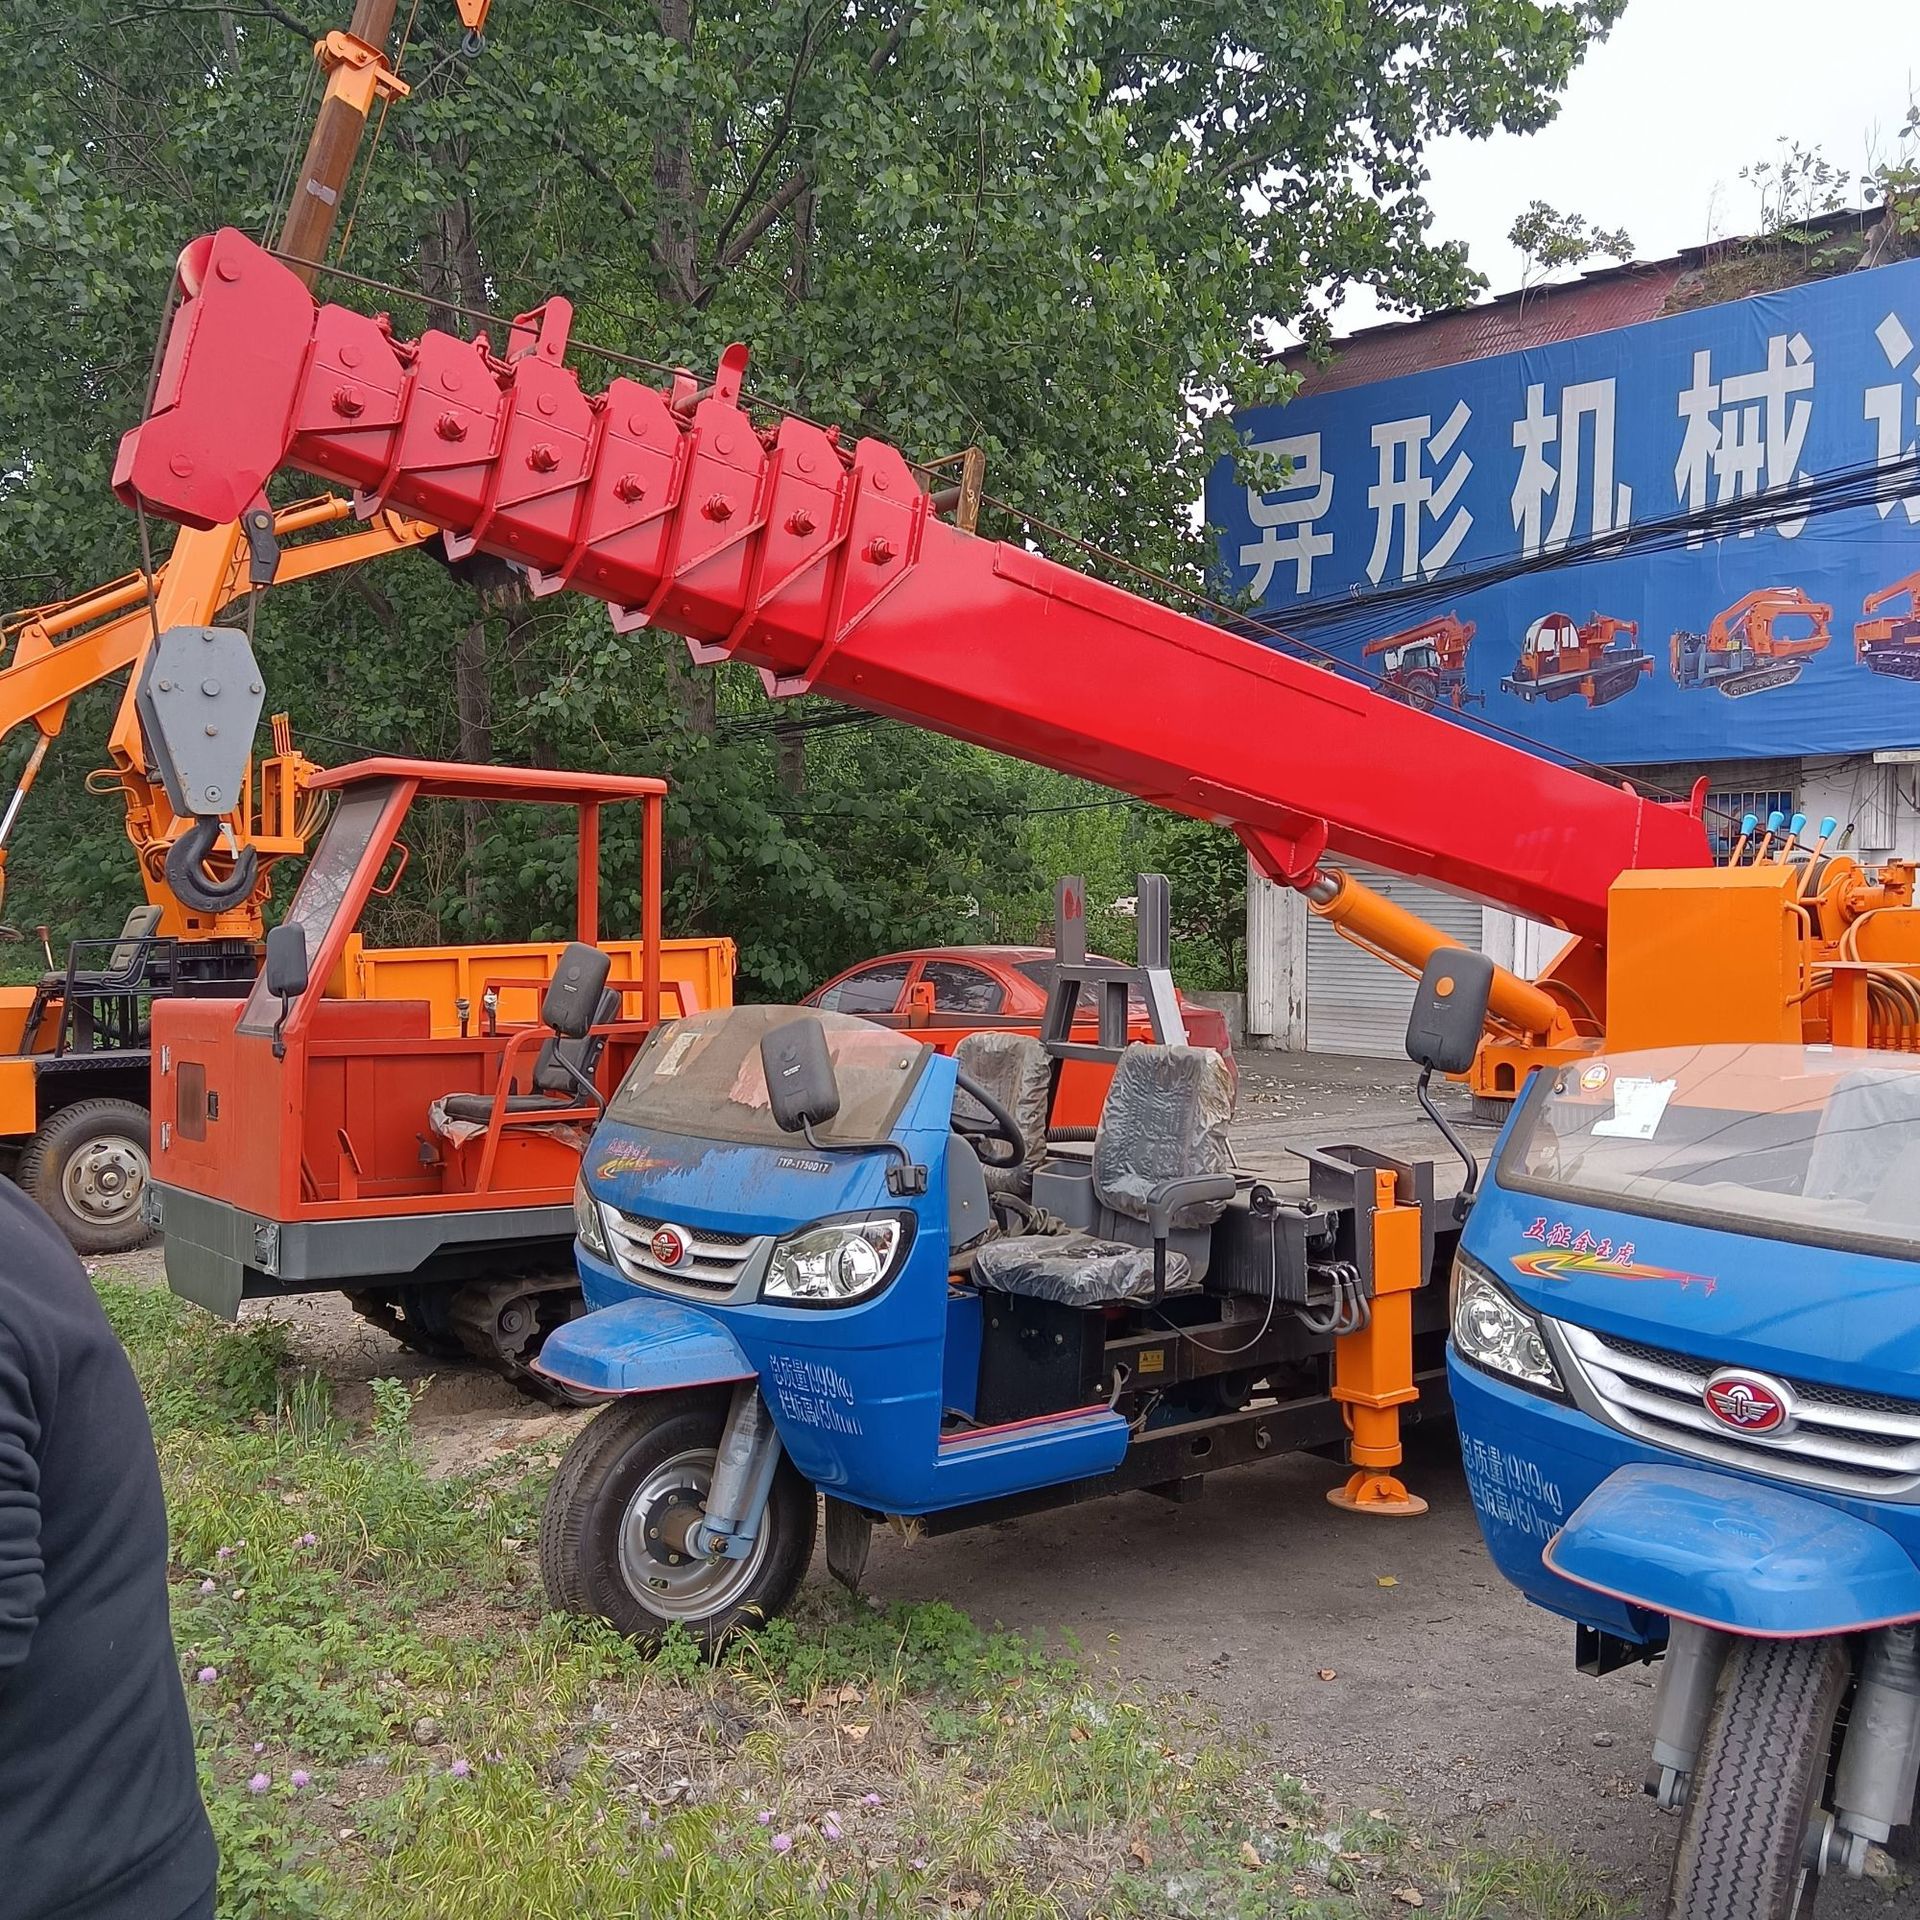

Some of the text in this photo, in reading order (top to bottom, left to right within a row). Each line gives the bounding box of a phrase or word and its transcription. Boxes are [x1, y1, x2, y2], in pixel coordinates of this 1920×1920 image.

[777, 1157, 830, 1173] 7YP-1750D17
[769, 1354, 854, 1406] 总质量1999kg
